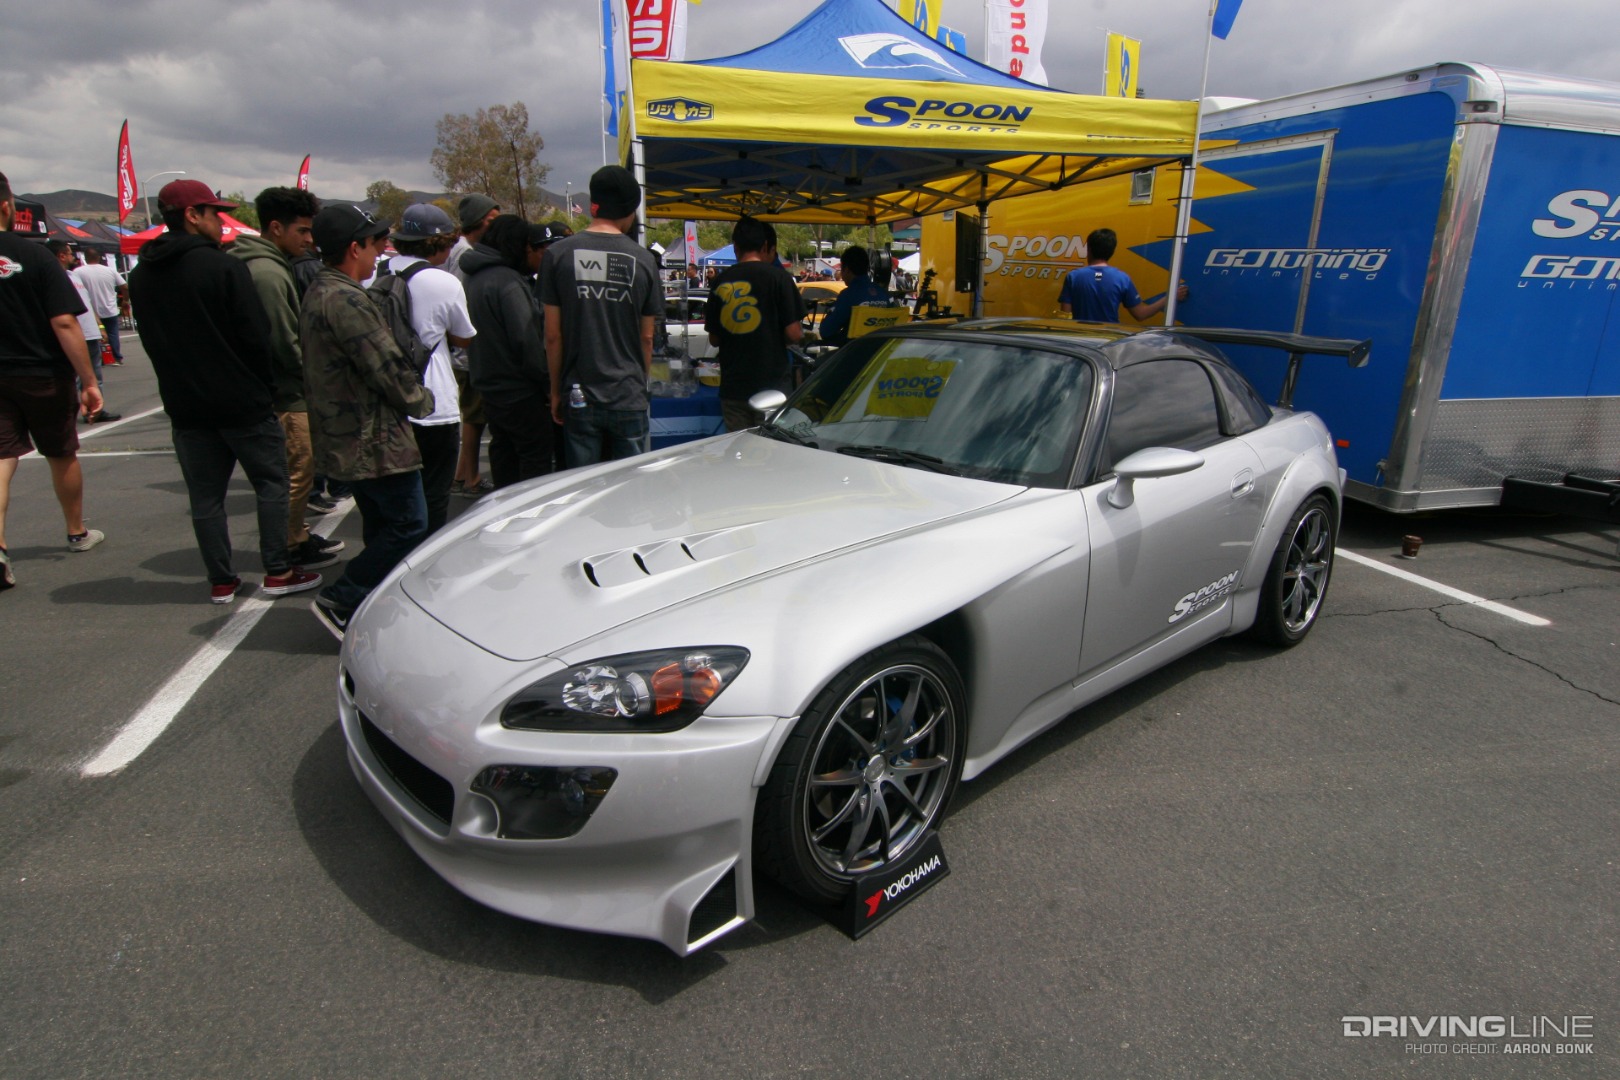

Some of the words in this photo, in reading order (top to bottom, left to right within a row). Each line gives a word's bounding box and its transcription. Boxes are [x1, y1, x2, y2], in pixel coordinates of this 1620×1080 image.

[854, 96, 1033, 127] SPOON
[907, 122, 1019, 134] SPORTS
[1000, 265, 1075, 280] SPORT
[1203, 269, 1378, 281] unlimited
[576, 285, 633, 304] RVCA
[1168, 570, 1239, 623] SPOON
[884, 855, 941, 901] YOKOHAMA
